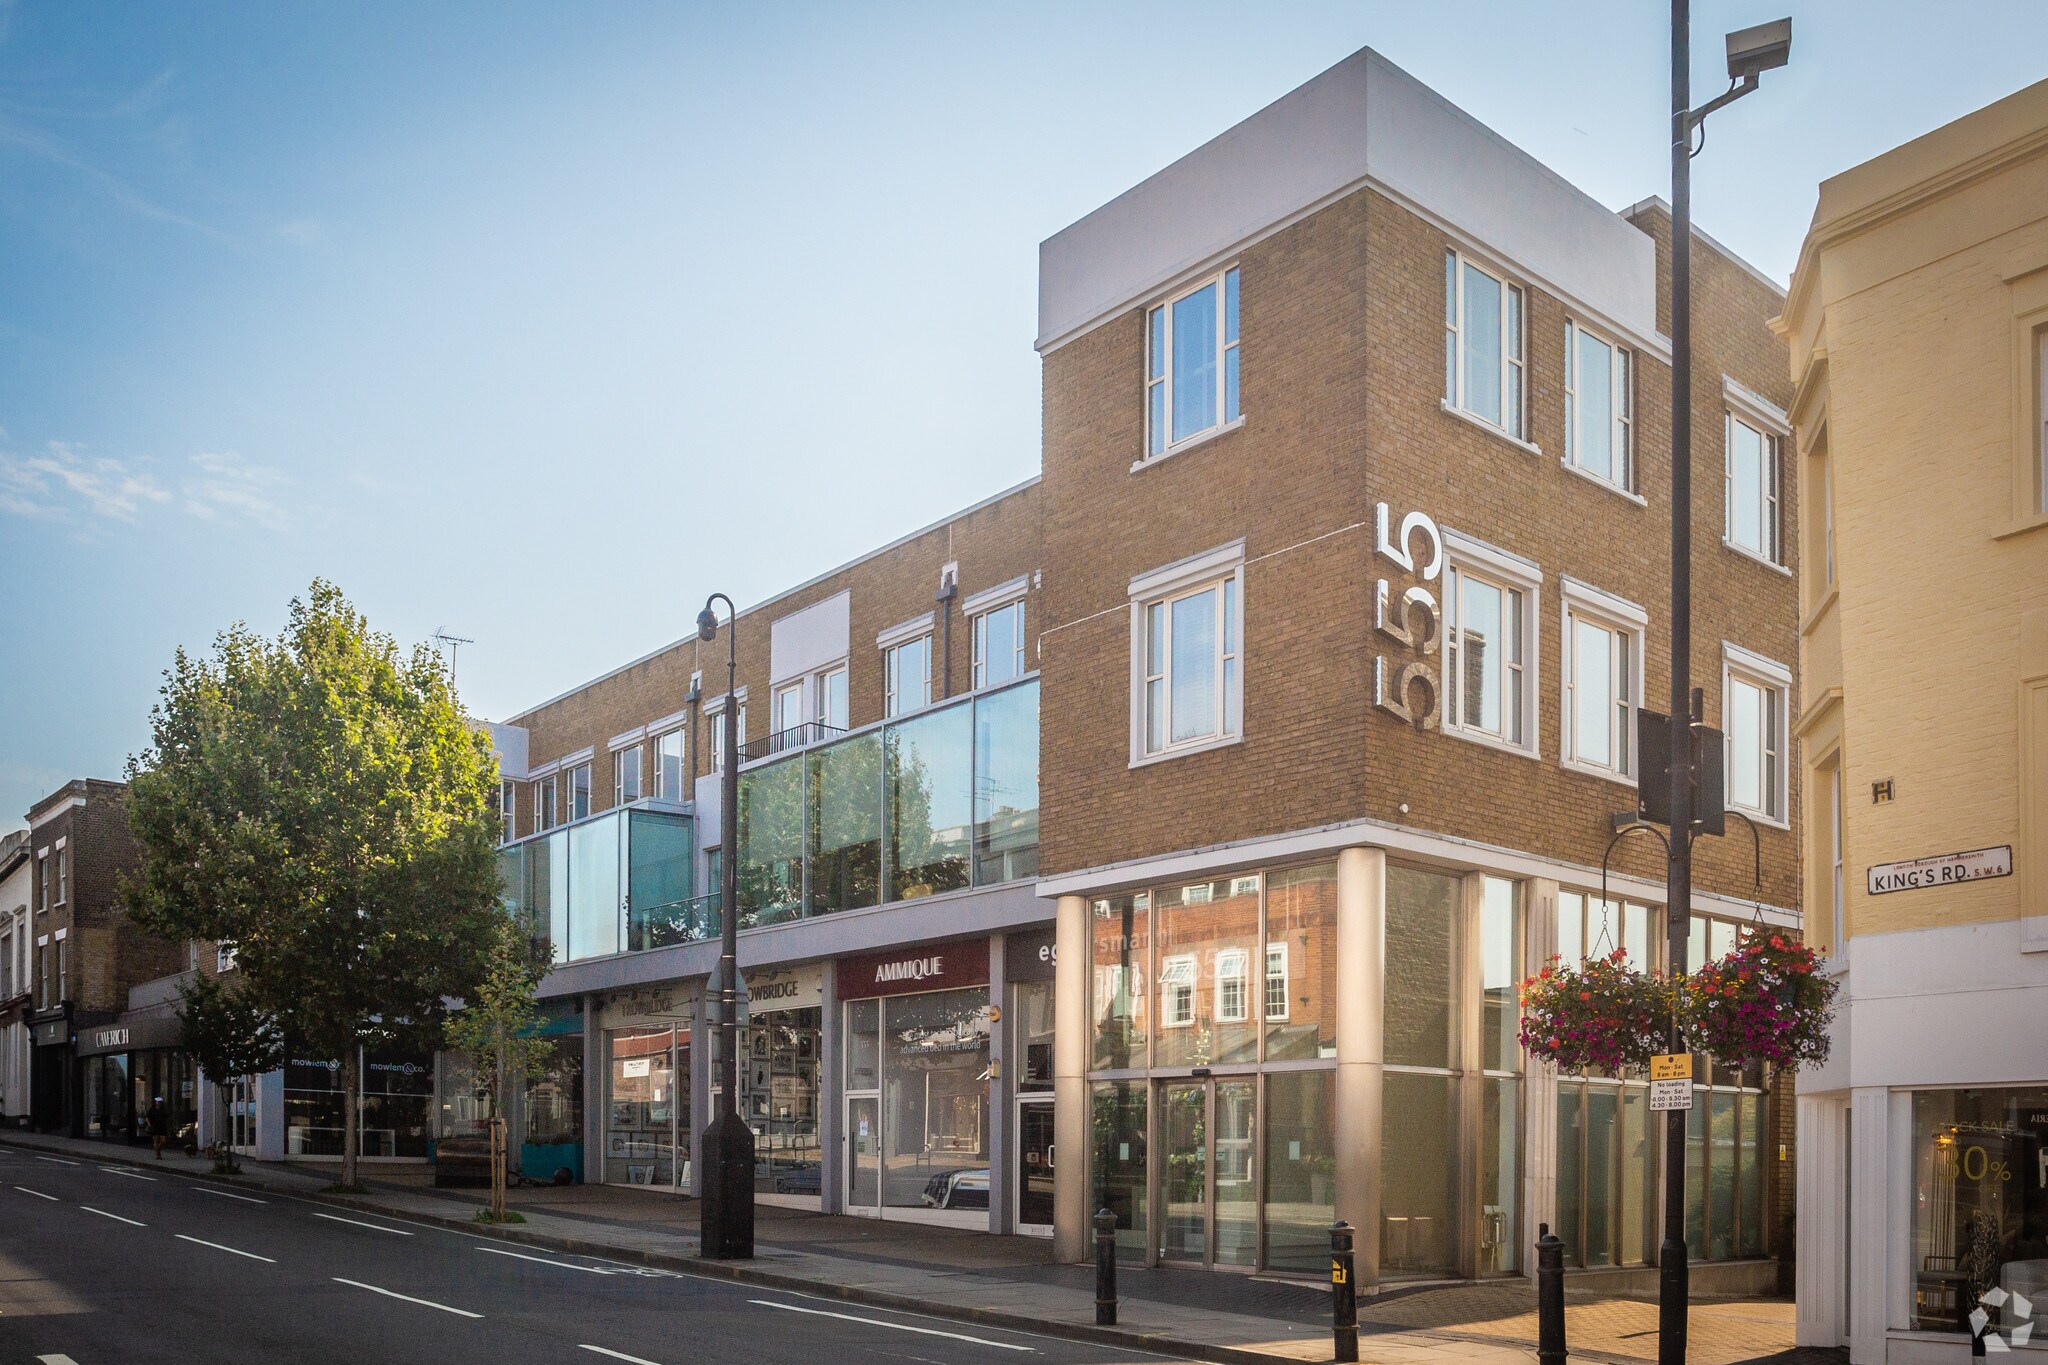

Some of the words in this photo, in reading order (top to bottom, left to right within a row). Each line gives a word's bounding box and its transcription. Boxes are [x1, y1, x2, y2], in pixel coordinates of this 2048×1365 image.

[1374, 501, 1442, 732] 555
[1872, 781, 1891, 804] H
[1875, 868, 1935, 891] KING'S
[1942, 864, 1971, 882] RD.
[875, 956, 944, 983] AMMIQUE
[746, 980, 799, 1003] OWBRIDGE
[900, 1045, 929, 1055] advanced
[950, 1042, 961, 1051] the
[962, 1041, 981, 1051] world
[1981, 1120, 2015, 1133] SALE
